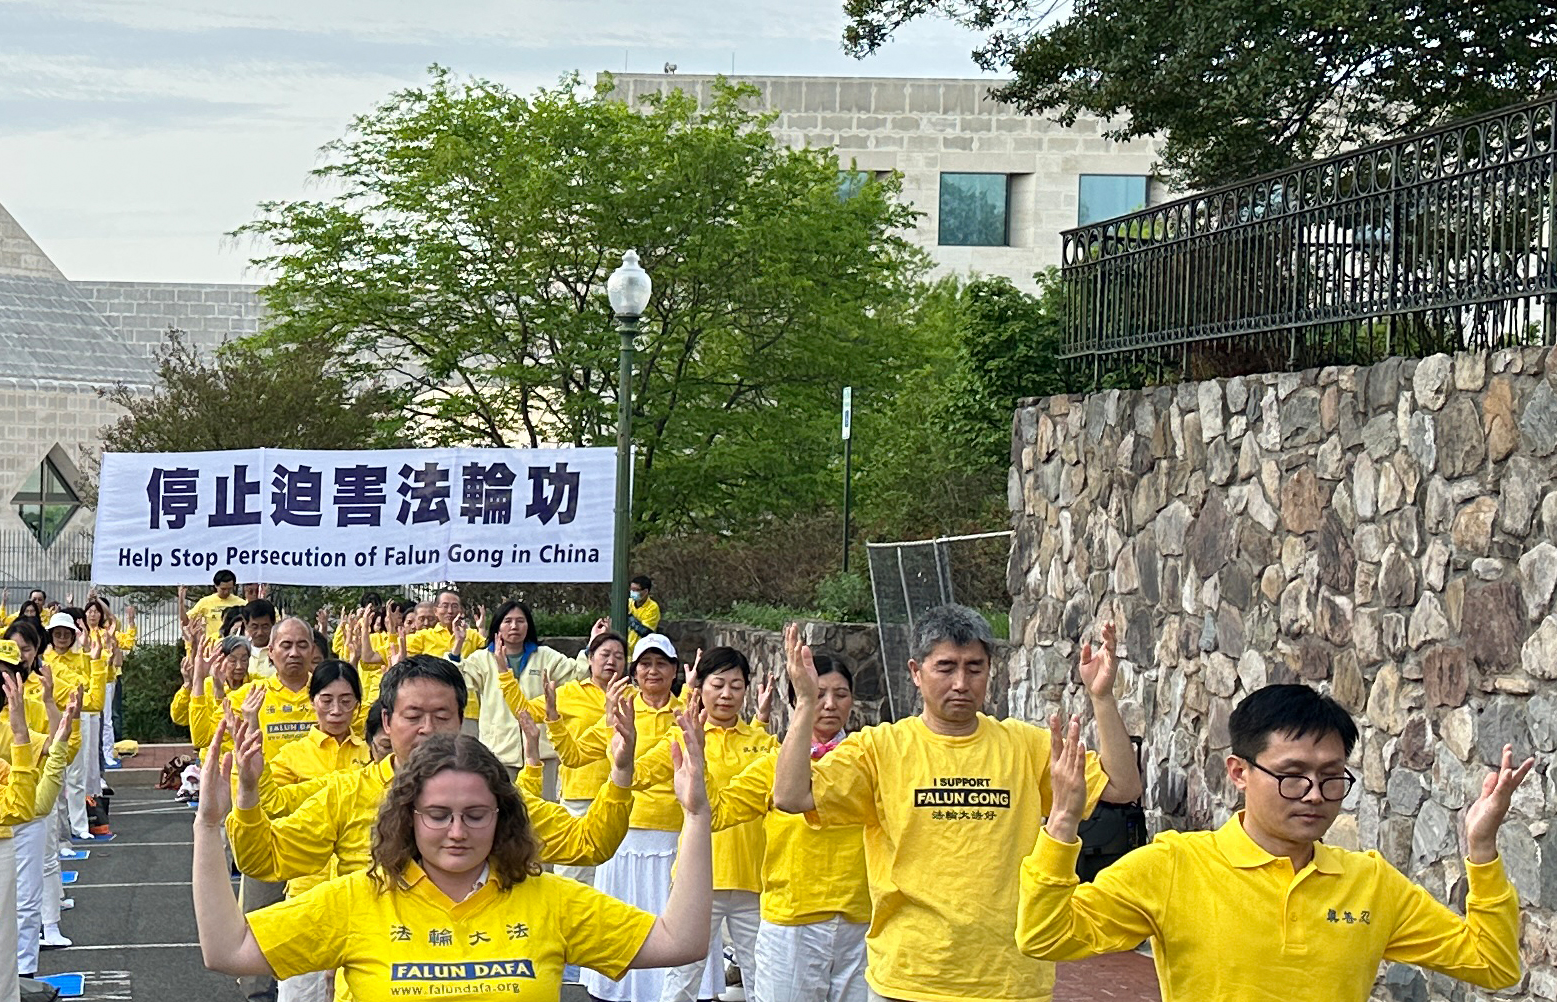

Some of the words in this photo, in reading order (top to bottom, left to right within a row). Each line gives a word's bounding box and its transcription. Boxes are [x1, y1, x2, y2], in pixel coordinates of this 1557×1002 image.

[146, 461, 581, 530] 停止迫害法輪功
[118, 547, 163, 571] Help
[170, 548, 218, 571] Stop
[226, 546, 346, 567] Persecution
[354, 545, 377, 566] of
[384, 544, 440, 566] Falun
[447, 543, 504, 568] Gong
[511, 543, 531, 564] in
[539, 543, 600, 564] China
[933, 778, 937, 787] I
[939, 778, 991, 787] SUPPORT
[917, 792, 965, 805] FALUN
[967, 793, 1009, 806] GONG
[390, 922, 530, 947] 法輪大法
[396, 964, 466, 978] FALUN
[474, 962, 531, 977] DAFA
[390, 982, 520, 995] www.falundafa.org
